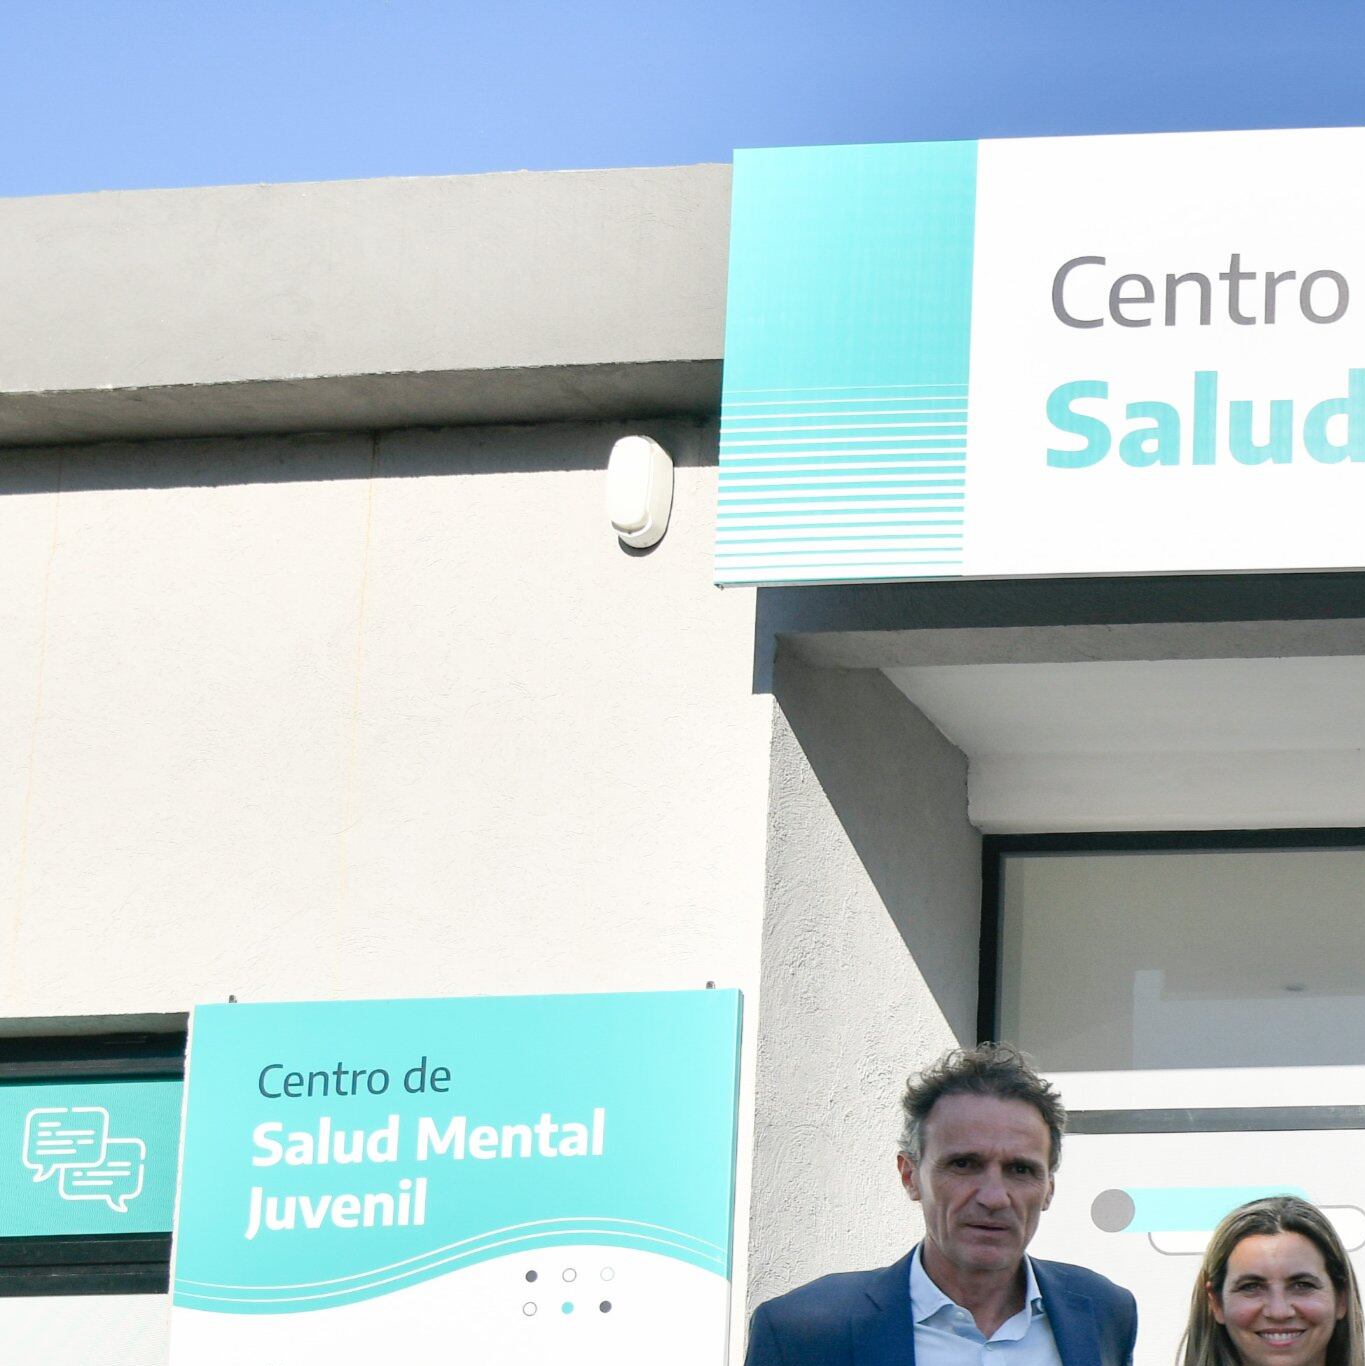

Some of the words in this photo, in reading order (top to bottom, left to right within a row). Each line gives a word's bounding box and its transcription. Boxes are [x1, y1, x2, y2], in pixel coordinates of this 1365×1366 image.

[1052, 253, 1350, 329] Centro
[258, 1061, 390, 1099] Centro
[404, 1056, 452, 1094] de
[252, 1114, 400, 1167] Salud
[416, 1107, 606, 1161] Mental
[244, 1177, 428, 1240] Juvenil
